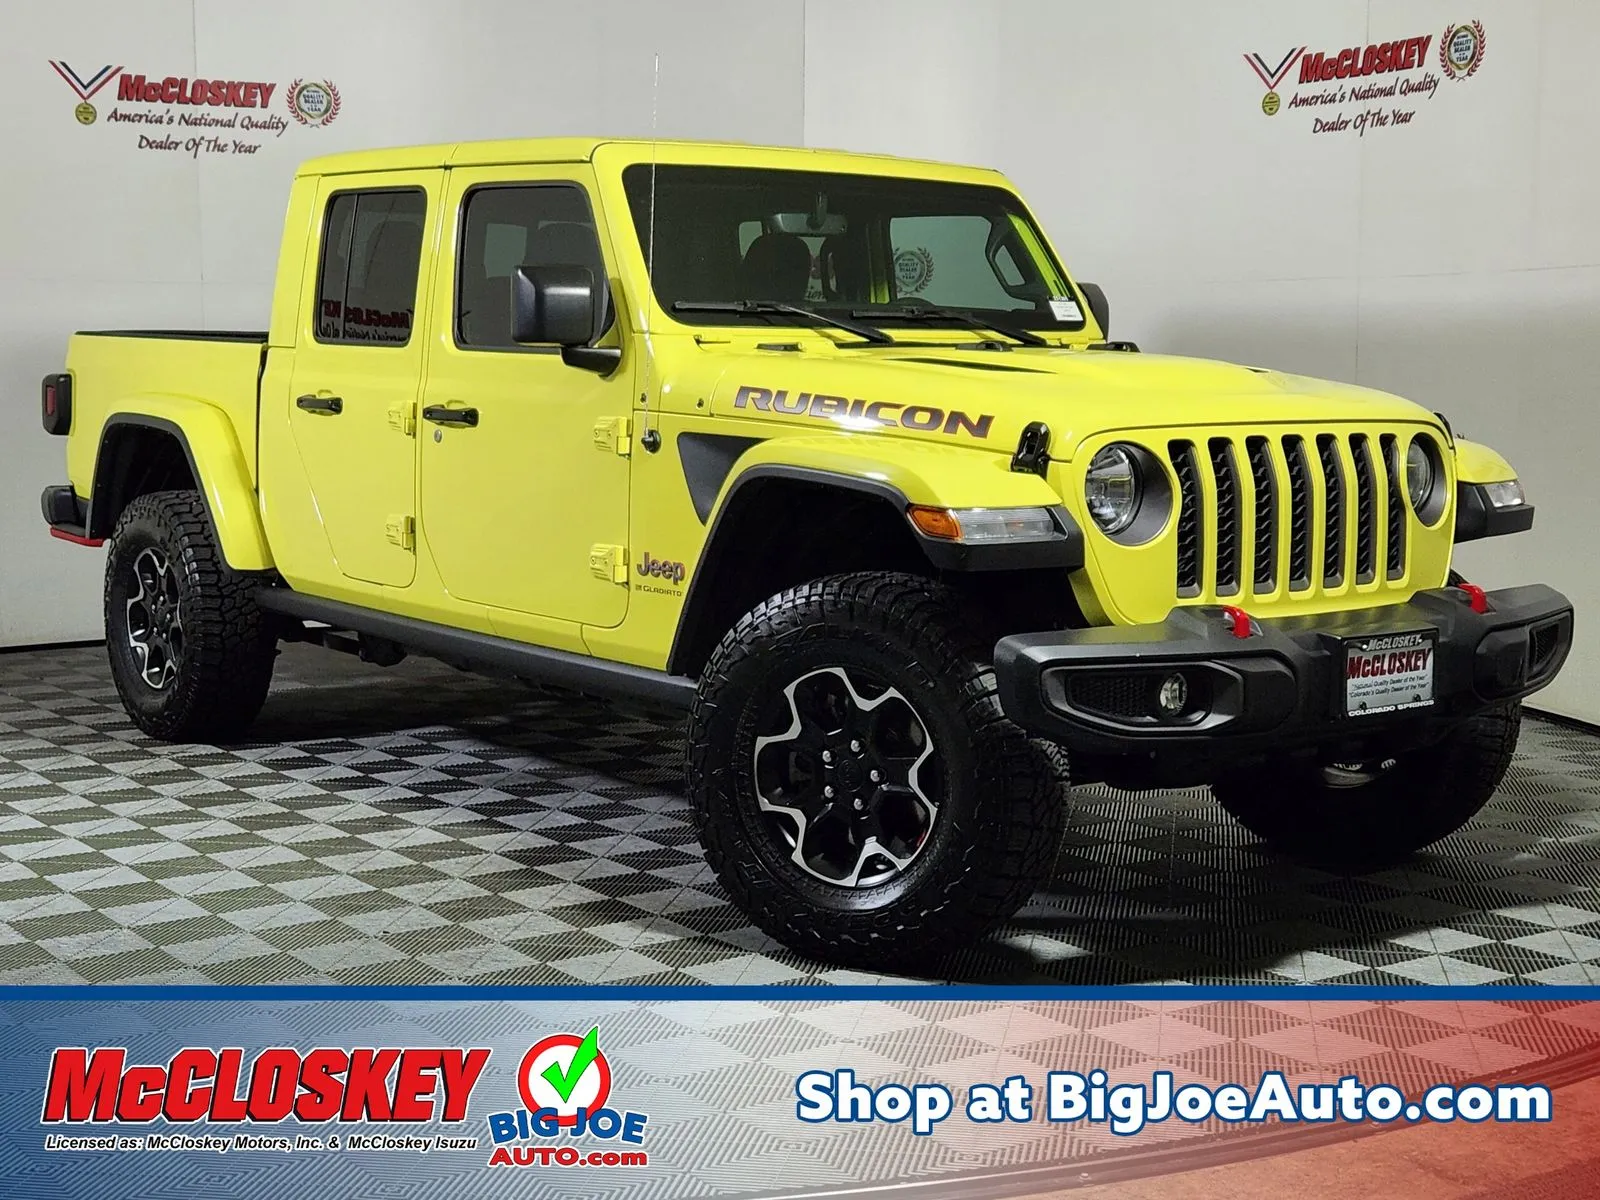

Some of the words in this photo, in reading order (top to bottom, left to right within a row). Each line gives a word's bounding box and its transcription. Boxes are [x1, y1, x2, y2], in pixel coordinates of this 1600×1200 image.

[1299, 35, 1432, 84] McCLOSKEY
[117, 74, 276, 108] McCLOSKEY
[1288, 84, 1346, 109] America's
[1349, 76, 1400, 102] National
[1399, 72, 1440, 99] Quality
[107, 108, 174, 125] America's
[178, 112, 238, 130] National
[240, 114, 288, 138] Quality
[1313, 112, 1352, 134] Dealer
[1353, 109, 1371, 137] Of
[1370, 107, 1389, 128] The
[1391, 109, 1416, 126] Year
[138, 134, 182, 151] Dealer
[185, 137, 205, 159] Of
[205, 136, 228, 153] The
[232, 140, 262, 154] Year
[734, 385, 995, 438] RUBICON
[637, 552, 686, 585] Jeep
[1367, 634, 1421, 651] McCLOSKEY
[1346, 647, 1432, 679] McCLOSKEY
[1348, 706, 1396, 716] COLORADO
[1397, 700, 1434, 710] SPRINGS
